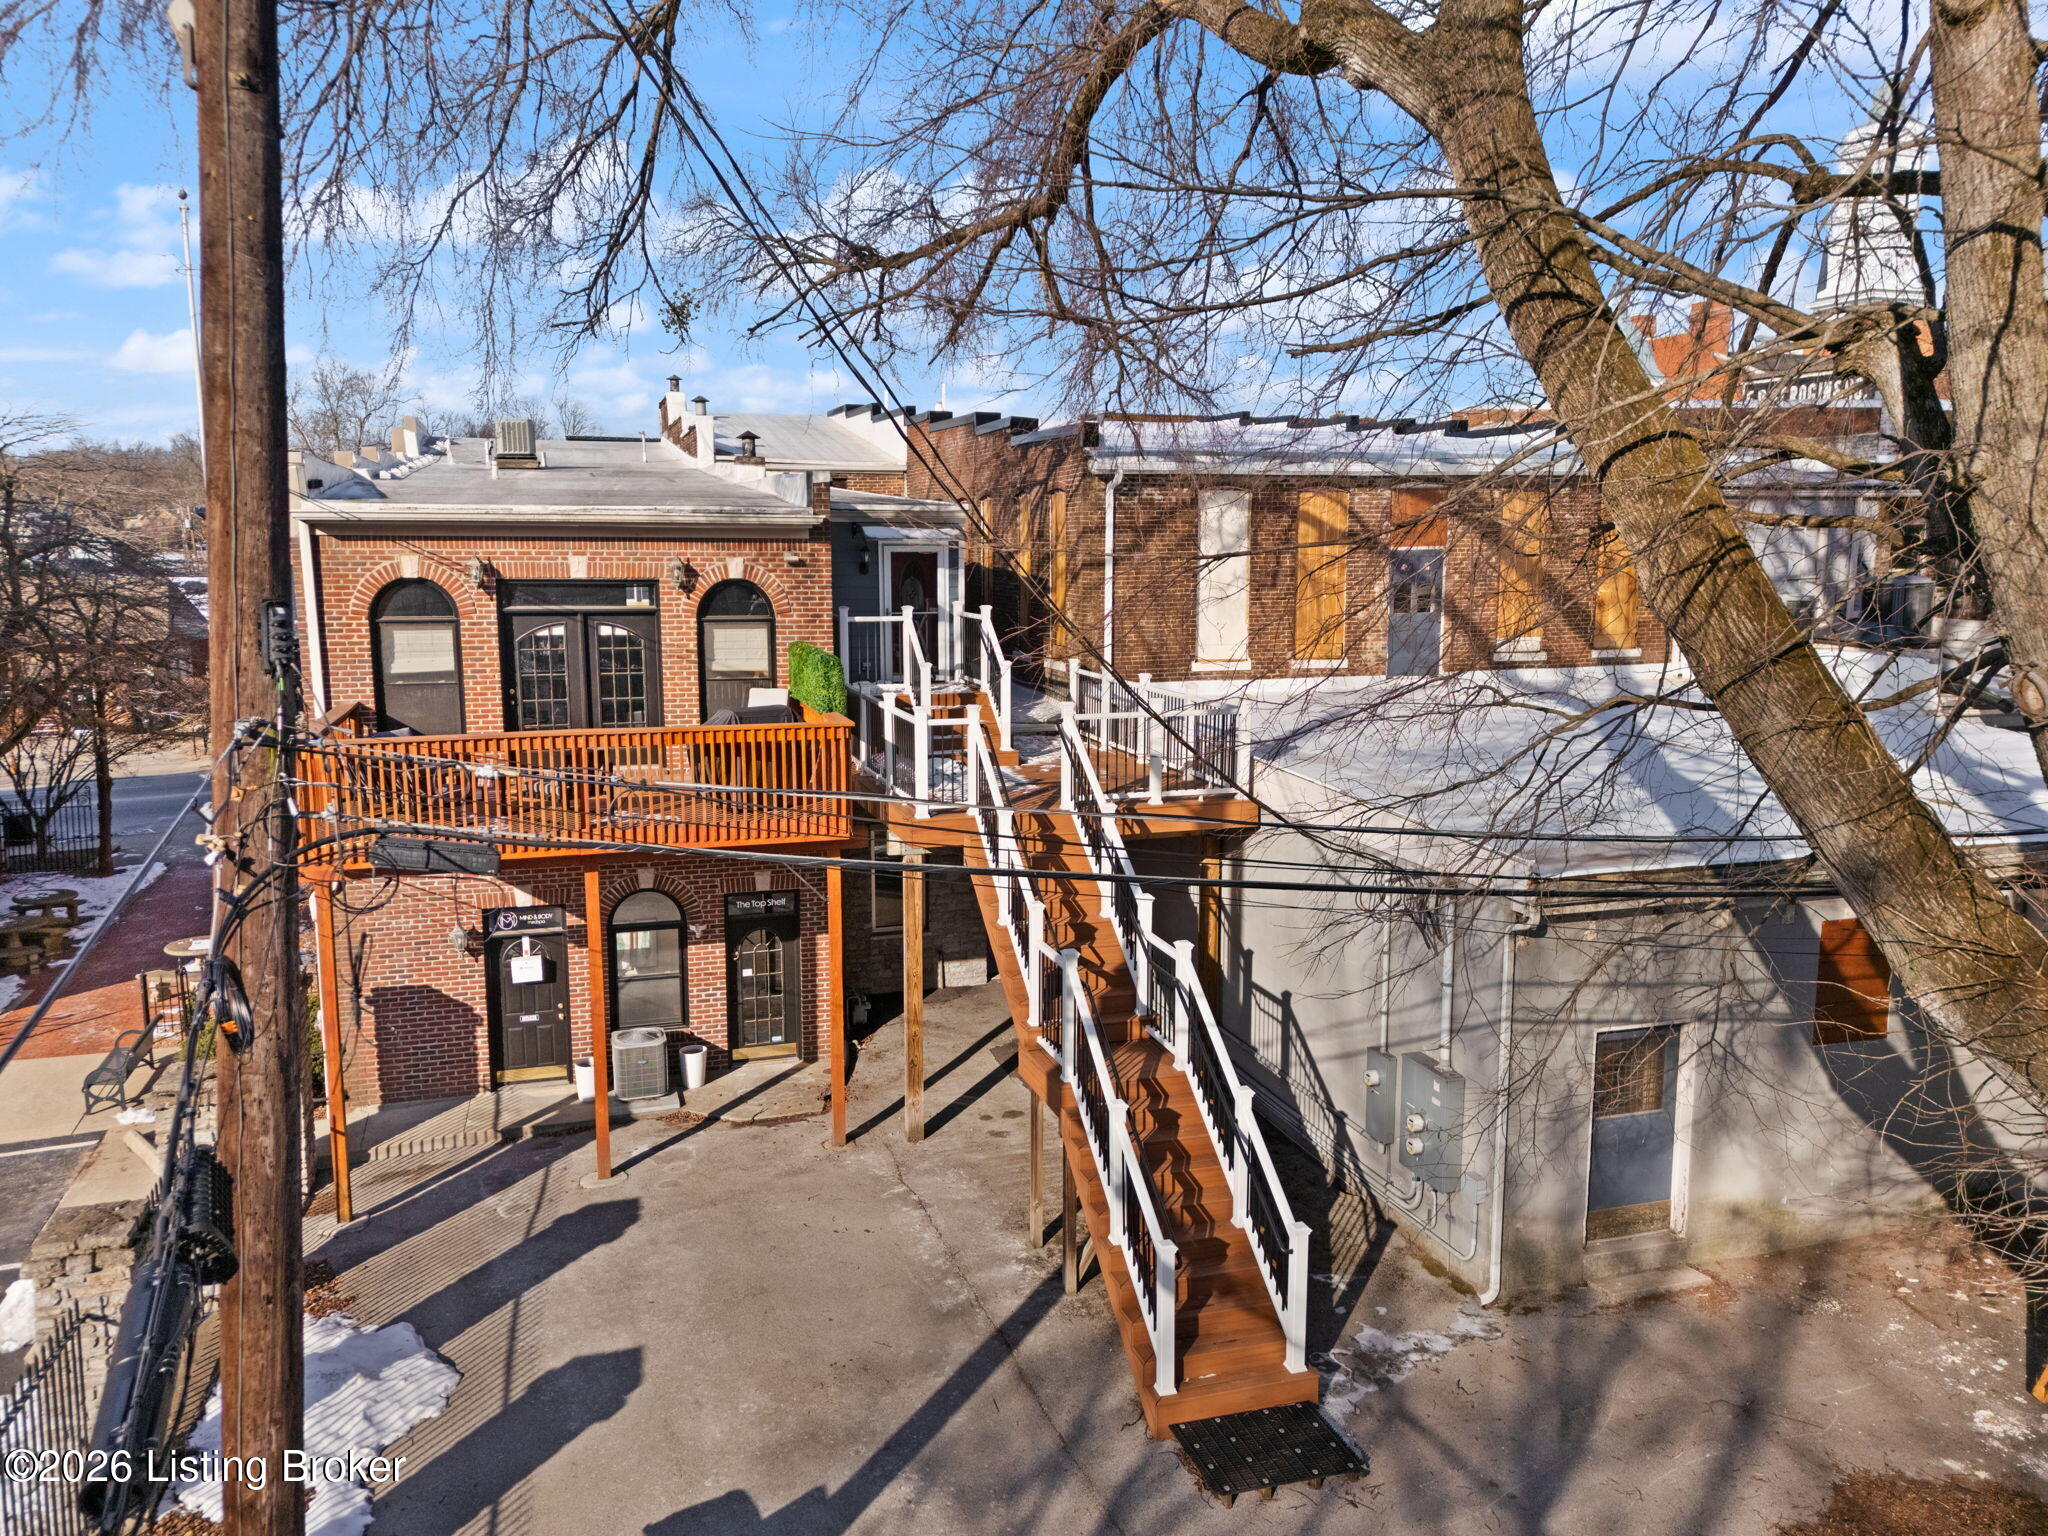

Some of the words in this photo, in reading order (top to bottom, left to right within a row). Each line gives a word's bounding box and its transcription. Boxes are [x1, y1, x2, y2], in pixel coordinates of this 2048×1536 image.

[736, 901, 751, 909] The
[751, 900, 767, 909] Top
[767, 897, 786, 907] Shelf
[538, 912, 553, 920] BODY
